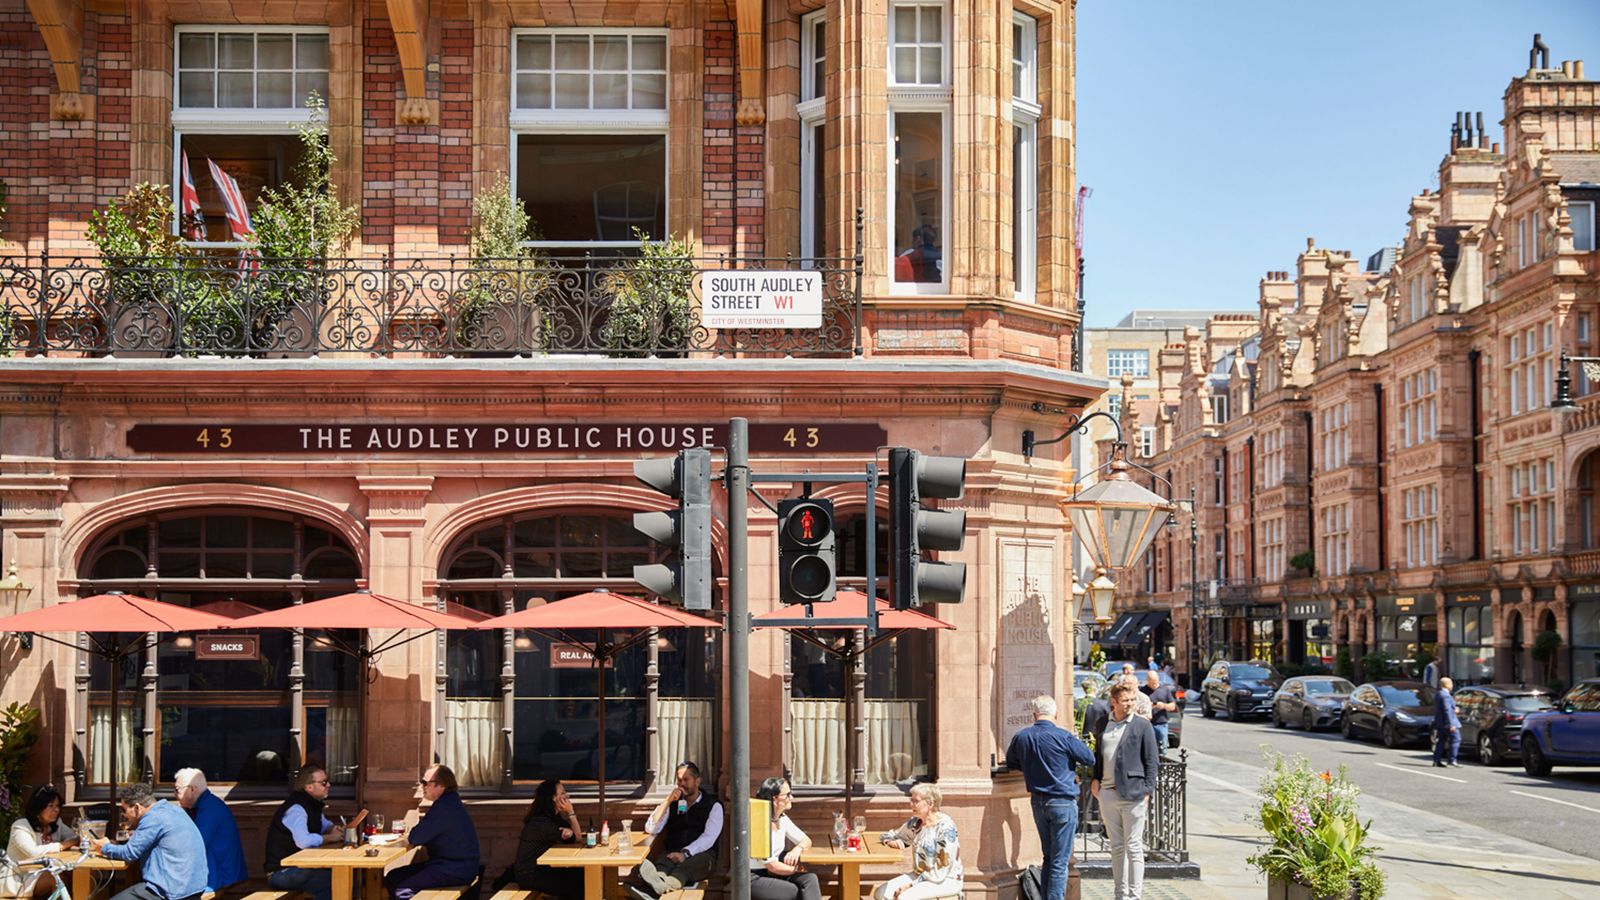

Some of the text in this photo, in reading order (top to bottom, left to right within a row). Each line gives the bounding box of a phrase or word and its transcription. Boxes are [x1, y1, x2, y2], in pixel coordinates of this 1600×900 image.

[711, 278, 814, 292] SOUTH AUDLEY
[711, 295, 794, 310] STREET W1
[196, 428, 820, 448] 43 THE AUDLEY PUBLIC HOUSE 43
[210, 643, 244, 651] SNACKS
[560, 651, 582, 660] REAL
